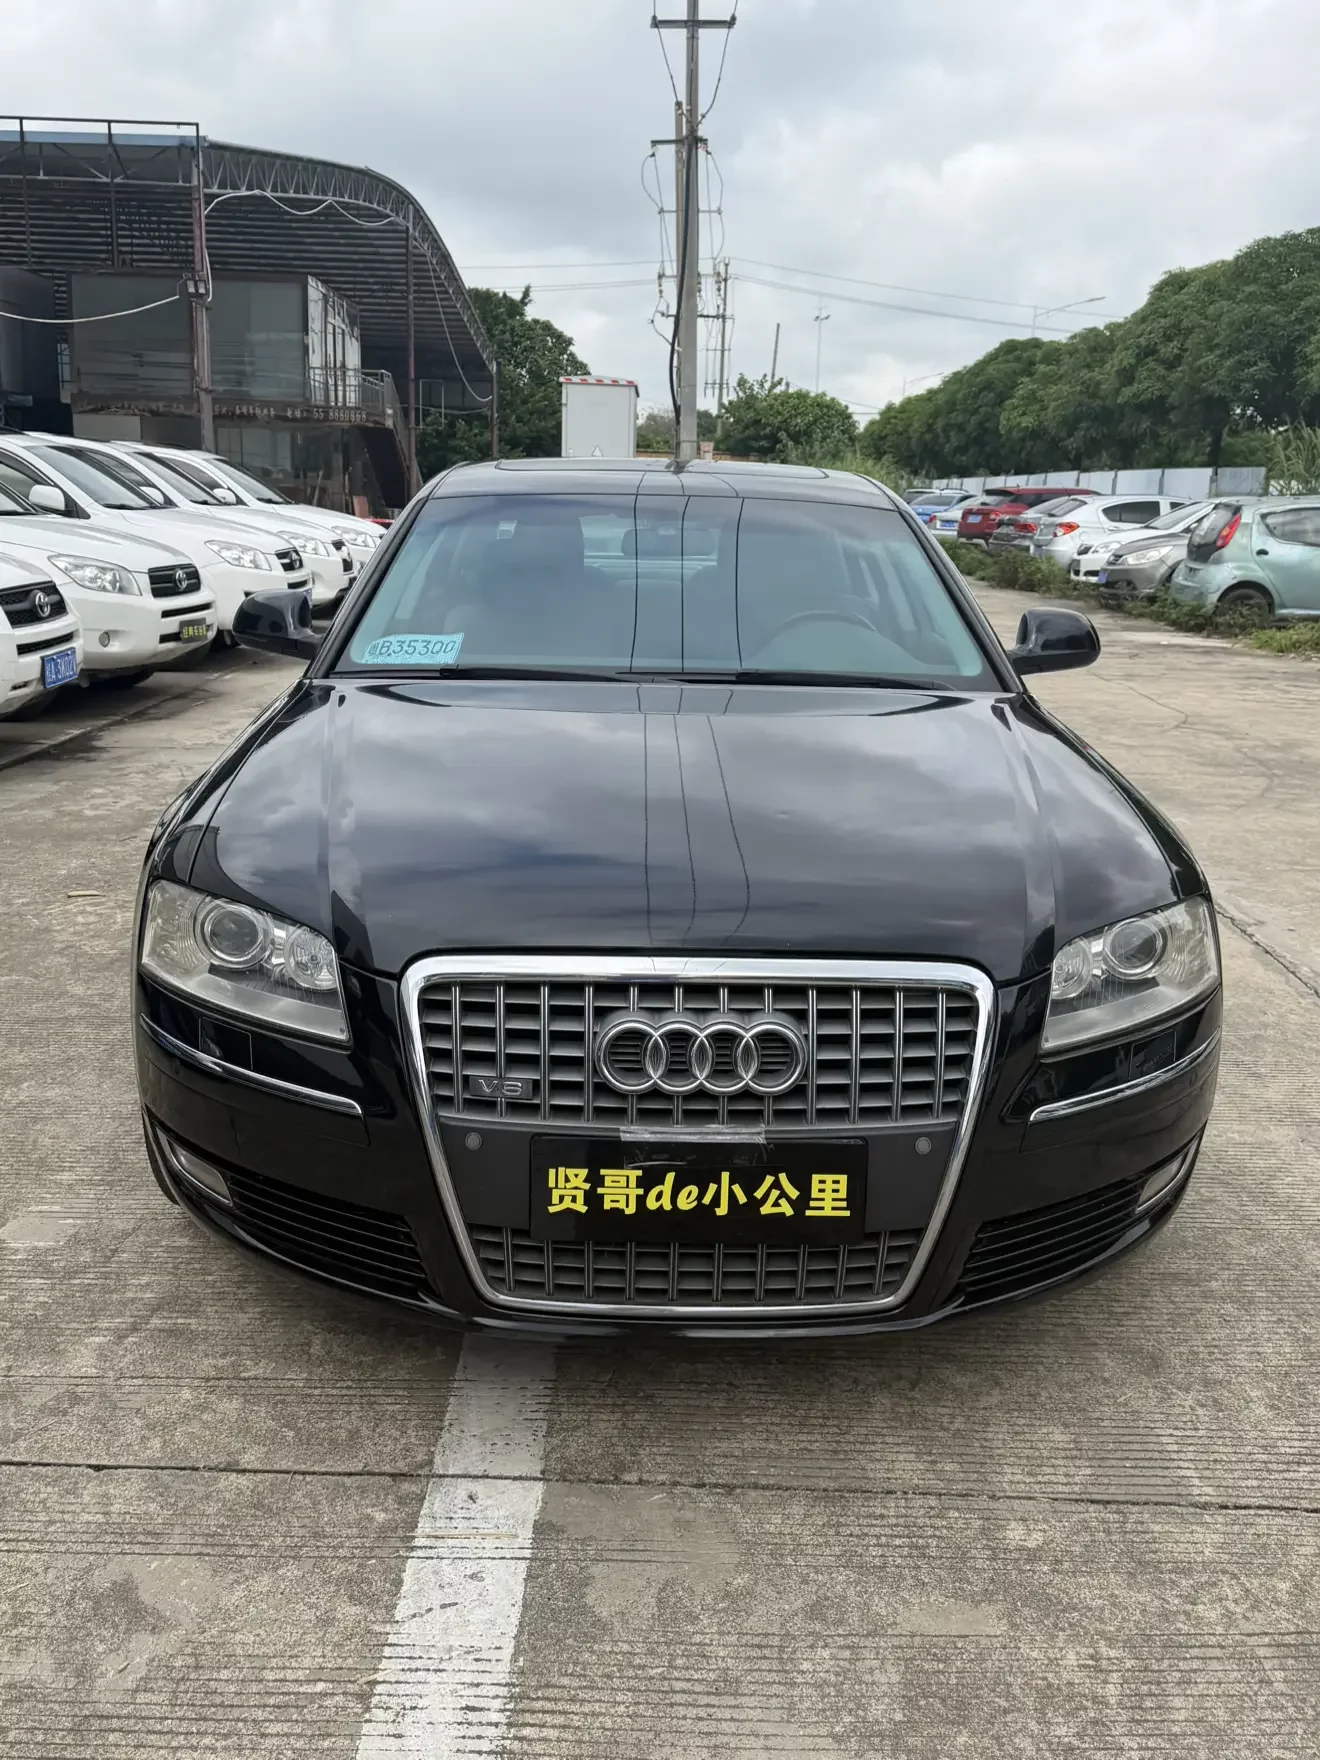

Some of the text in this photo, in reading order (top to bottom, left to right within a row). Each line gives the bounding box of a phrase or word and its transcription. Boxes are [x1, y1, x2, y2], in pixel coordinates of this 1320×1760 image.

[547, 1166, 851, 1217] 贤哥de小公里
